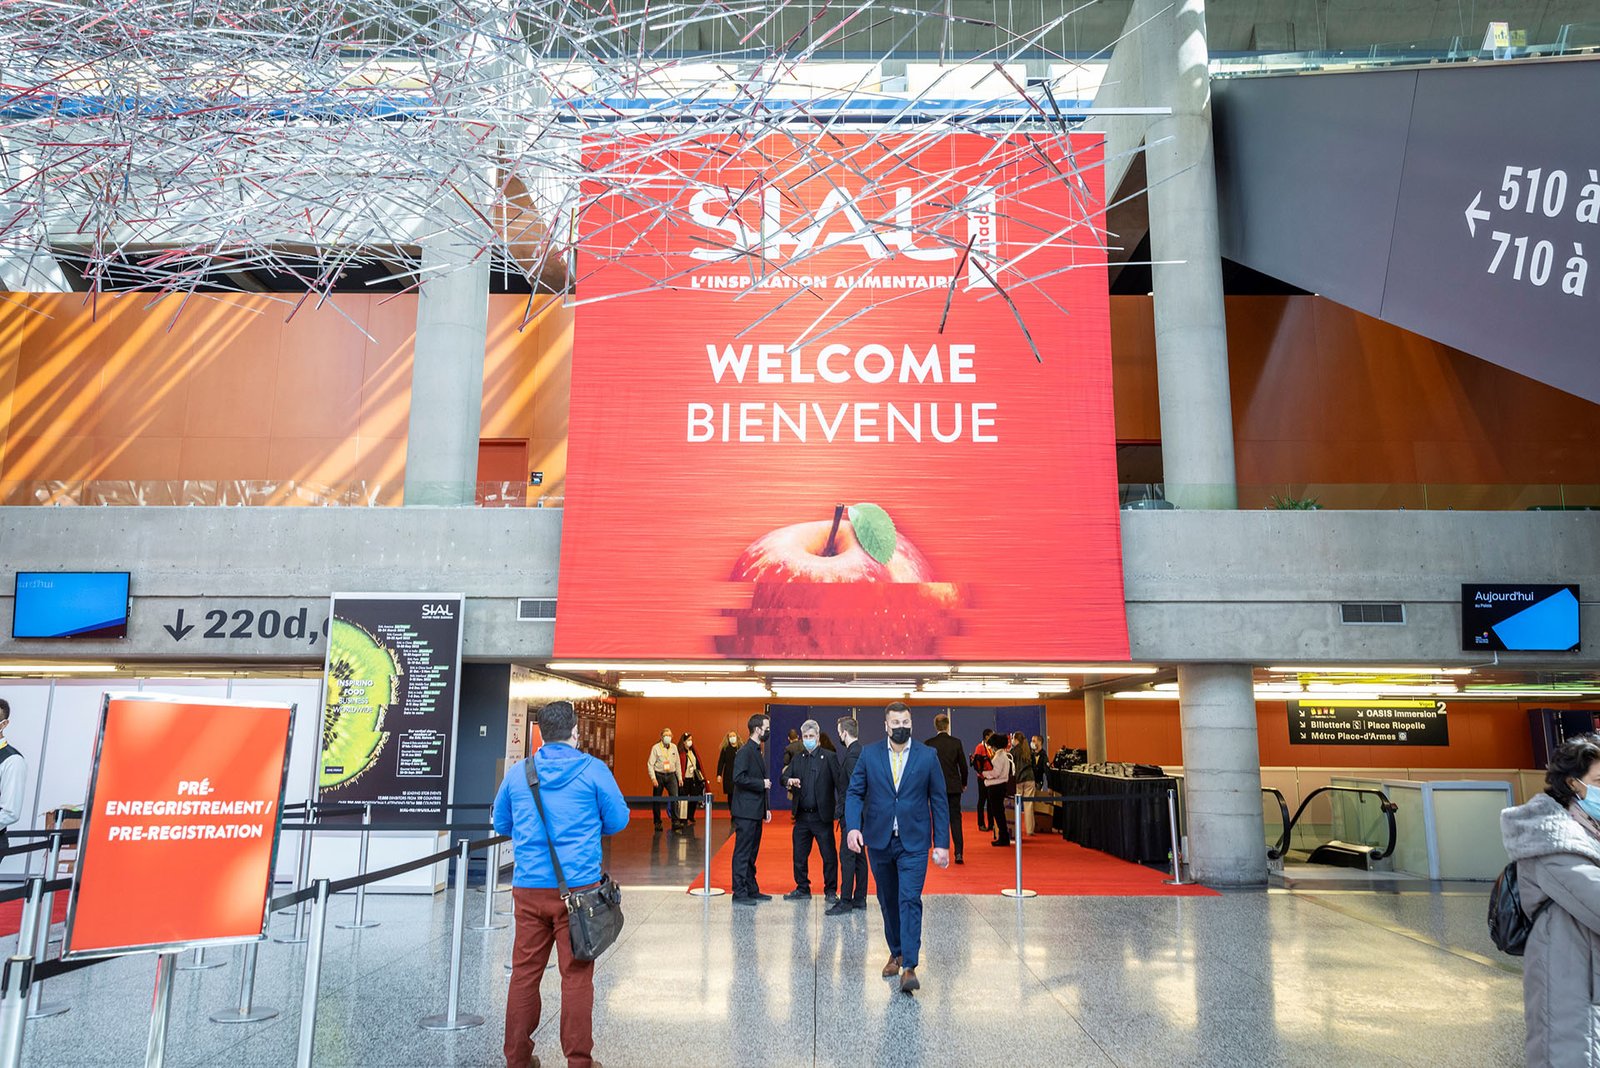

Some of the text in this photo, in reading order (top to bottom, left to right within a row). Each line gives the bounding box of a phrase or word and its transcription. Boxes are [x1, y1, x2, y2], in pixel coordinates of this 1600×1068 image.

[1499, 165, 1600, 224] 510 à
[688, 186, 958, 261] SIAL
[1488, 230, 1588, 297] 710 à
[706, 343, 977, 384] WELCOME
[686, 402, 999, 443] BIENVENUE
[1475, 591, 1535, 603] Aujourd'hui
[421, 604, 454, 616] SIAL
[203, 608, 330, 645] 220d,
[336, 679, 375, 687] INSPIRING
[343, 688, 366, 696] FOOD
[1366, 709, 1393, 718] OASIS
[1436, 701, 1447, 715] 2
[1310, 721, 1426, 731] Billetterie Place Riopelle
[1311, 732, 1396, 741] Métro Place-d'Armes
[177, 778, 215, 796] PRÉ-
[108, 824, 263, 841] PRE-REGISTRATION
